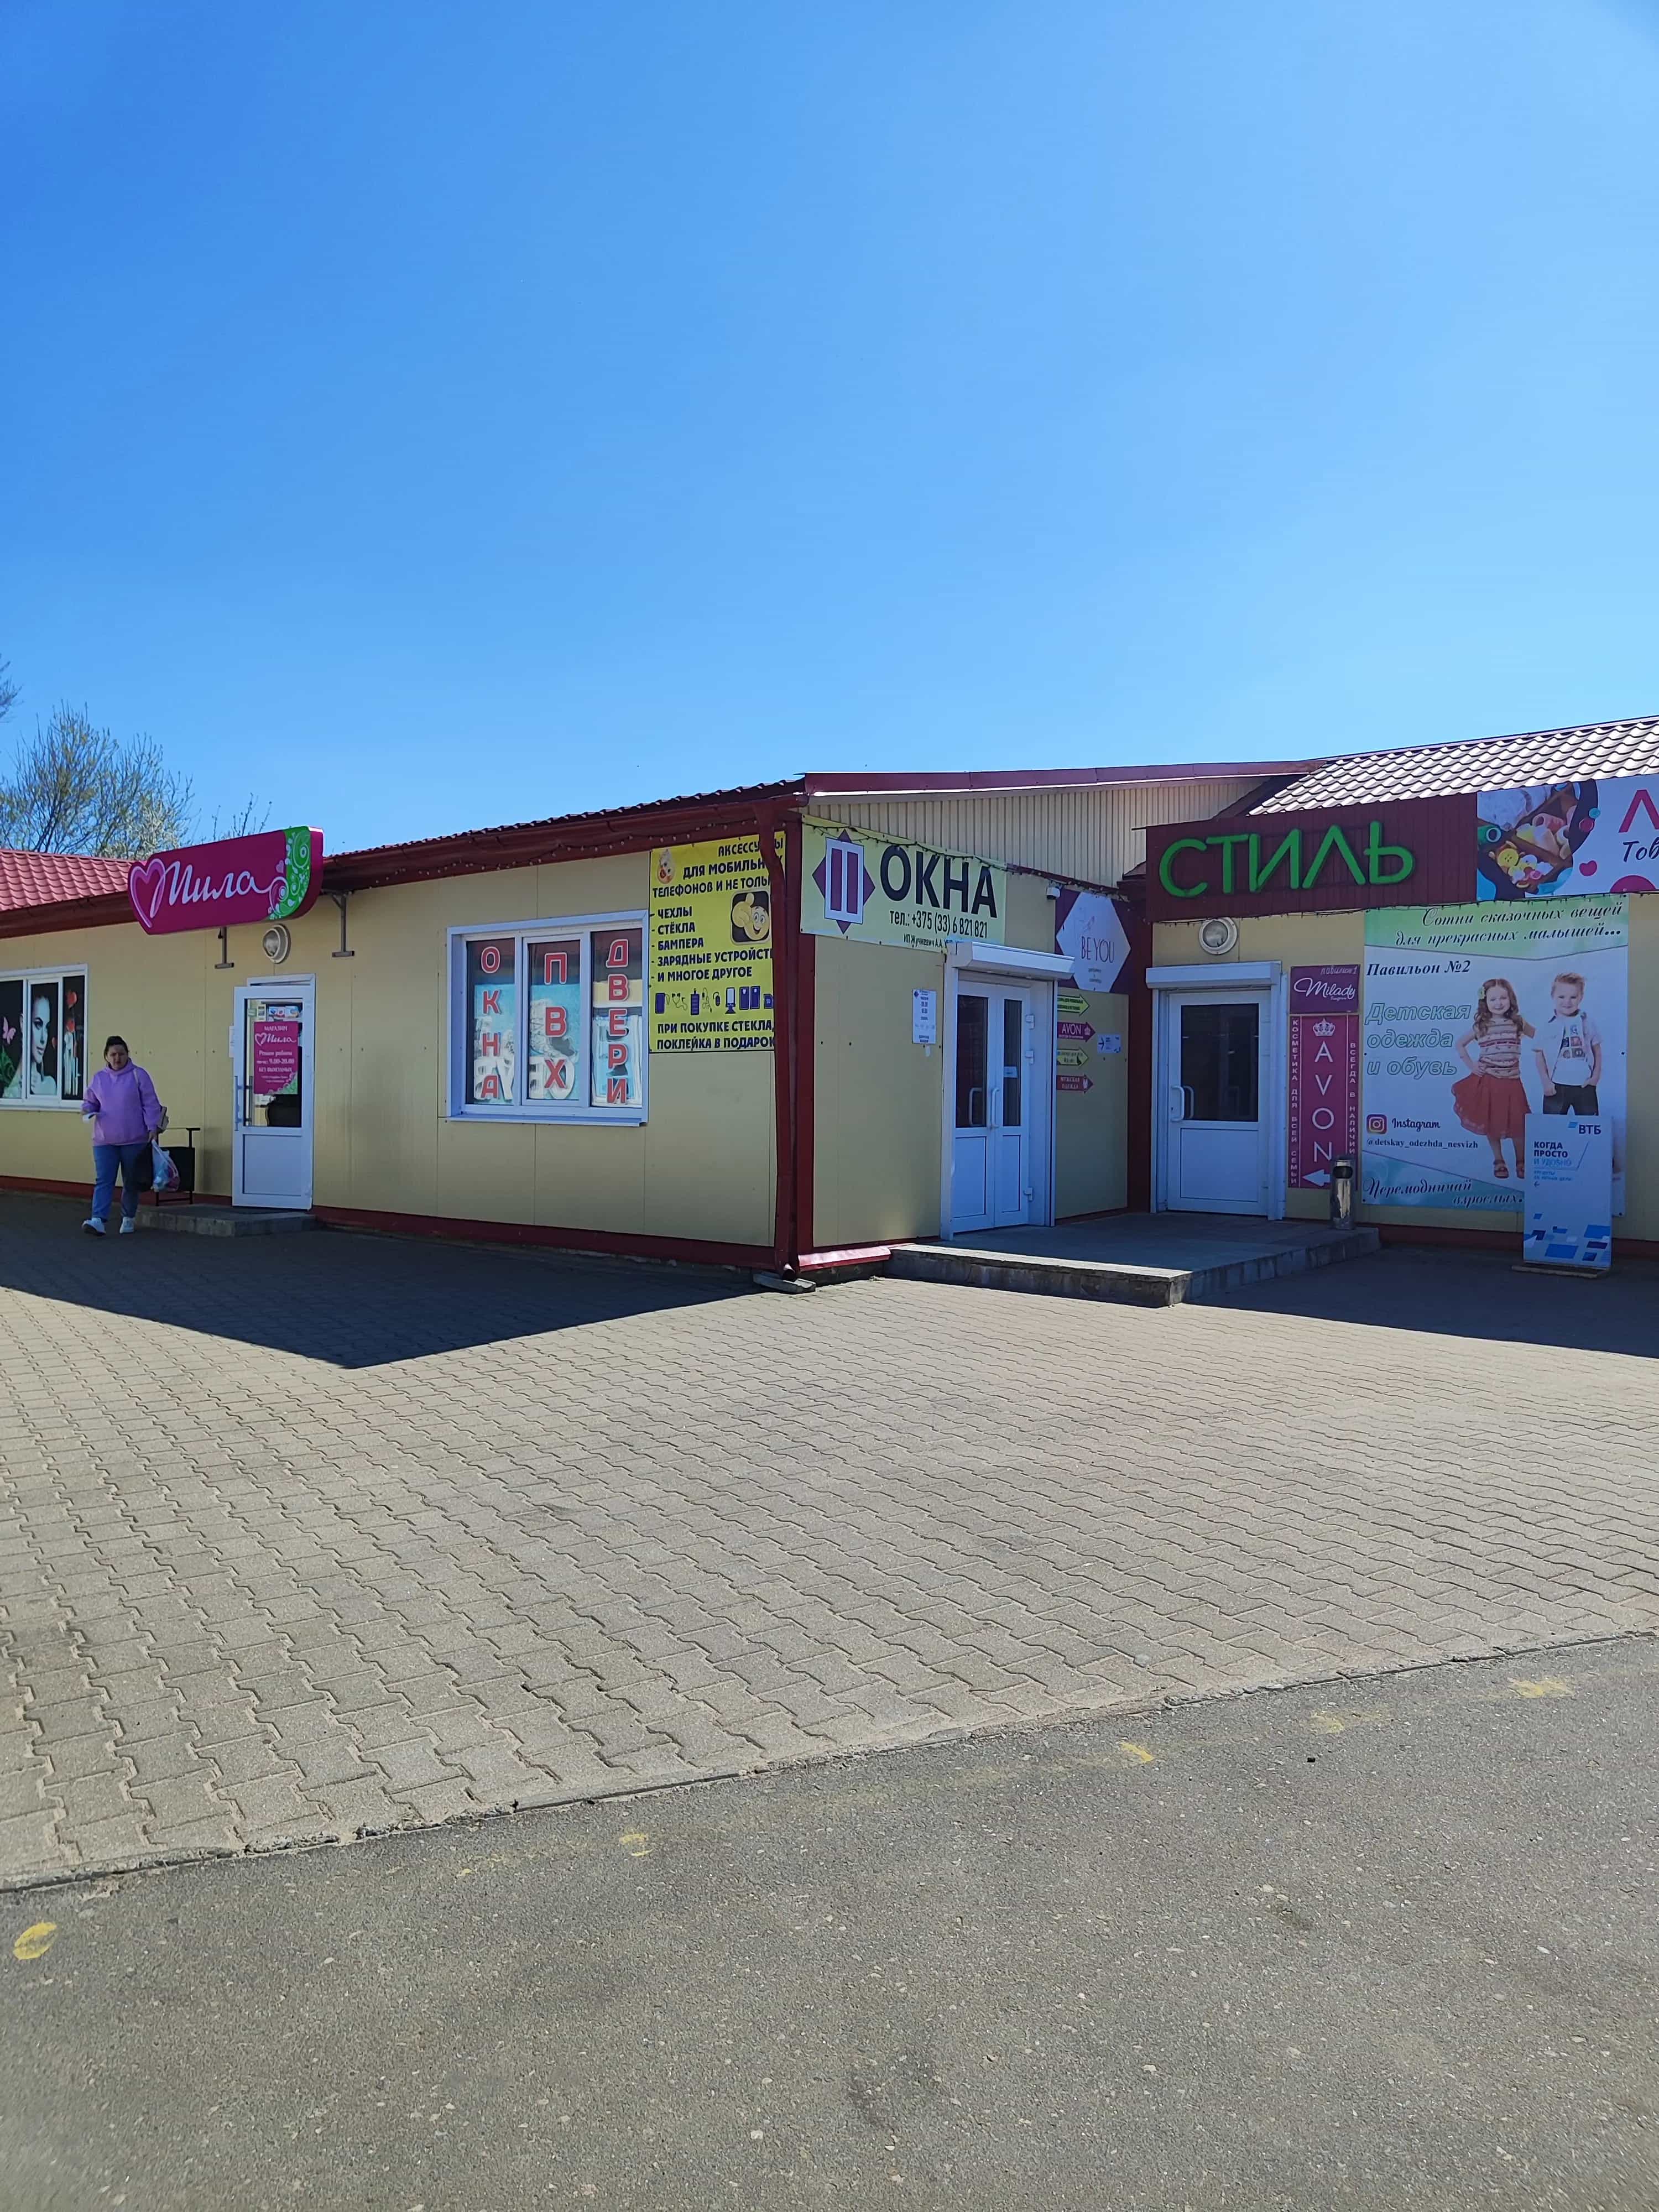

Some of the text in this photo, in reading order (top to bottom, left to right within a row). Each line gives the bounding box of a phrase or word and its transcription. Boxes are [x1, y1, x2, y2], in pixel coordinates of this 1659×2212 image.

[718, 838, 783, 857] АКСЕССУЫ
[683, 856, 782, 880] ДЛЯ МОБИЛЬН
[1159, 821, 1416, 898] СТИЛЬ
[150, 860, 263, 919] Мила
[653, 876, 770, 898] ТЕЛЕФОНОВ И НЕ ТОЛЬ
[880, 845, 997, 919] ОКНА
[658, 906, 692, 919] ЧЕХЛЫ
[1422, 902, 1623, 926] Сотни сказочных вещей
[658, 922, 695, 935] СТЁКЛА
[912, 910, 932, 930] +375
[935, 913, 950, 936] (33)
[953, 916, 957, 933] 6
[658, 938, 704, 951] БАМПЕРА
[1396, 931, 1421, 946] для
[1428, 931, 1519, 947] прекрасных
[658, 947, 772, 967] ЗАРЯДНЫЕ УСТРОЙСТ
[1081, 936, 1115, 963] BE YOU
[658, 967, 752, 982] И МНОГОЕ ДРУГОЕ
[1367, 960, 1471, 976] Павильон №2
[1293, 977, 1355, 1000] Milady
[481, 946, 500, 1098] ОКНА
[544, 952, 567, 1089] ПВХ
[606, 939, 629, 1104] ДВЕРИ
[1364, 1003, 1472, 1025] Детская
[658, 1024, 677, 1034] ПРИ
[680, 1021, 729, 1033] ПОКУПКЕ
[1062, 1024, 1081, 1035] AVON
[262, 1032, 297, 1045] Мила
[657, 1037, 712, 1050] ПОКЛЕЙКА
[715, 1038, 720, 1048] В
[1367, 1029, 1454, 1048] одежда
[1367, 1056, 1457, 1079] и обувь
[1312, 1041, 1334, 1162] AVON
[1391, 1118, 1441, 1132] Instagram
[1579, 1124, 1601, 1135] ВТБ
[1534, 1141, 1563, 1150] КОГДА
[1534, 1150, 1568, 1158] ПРОСТО
[1363, 1177, 1472, 1199] Перемодничай
